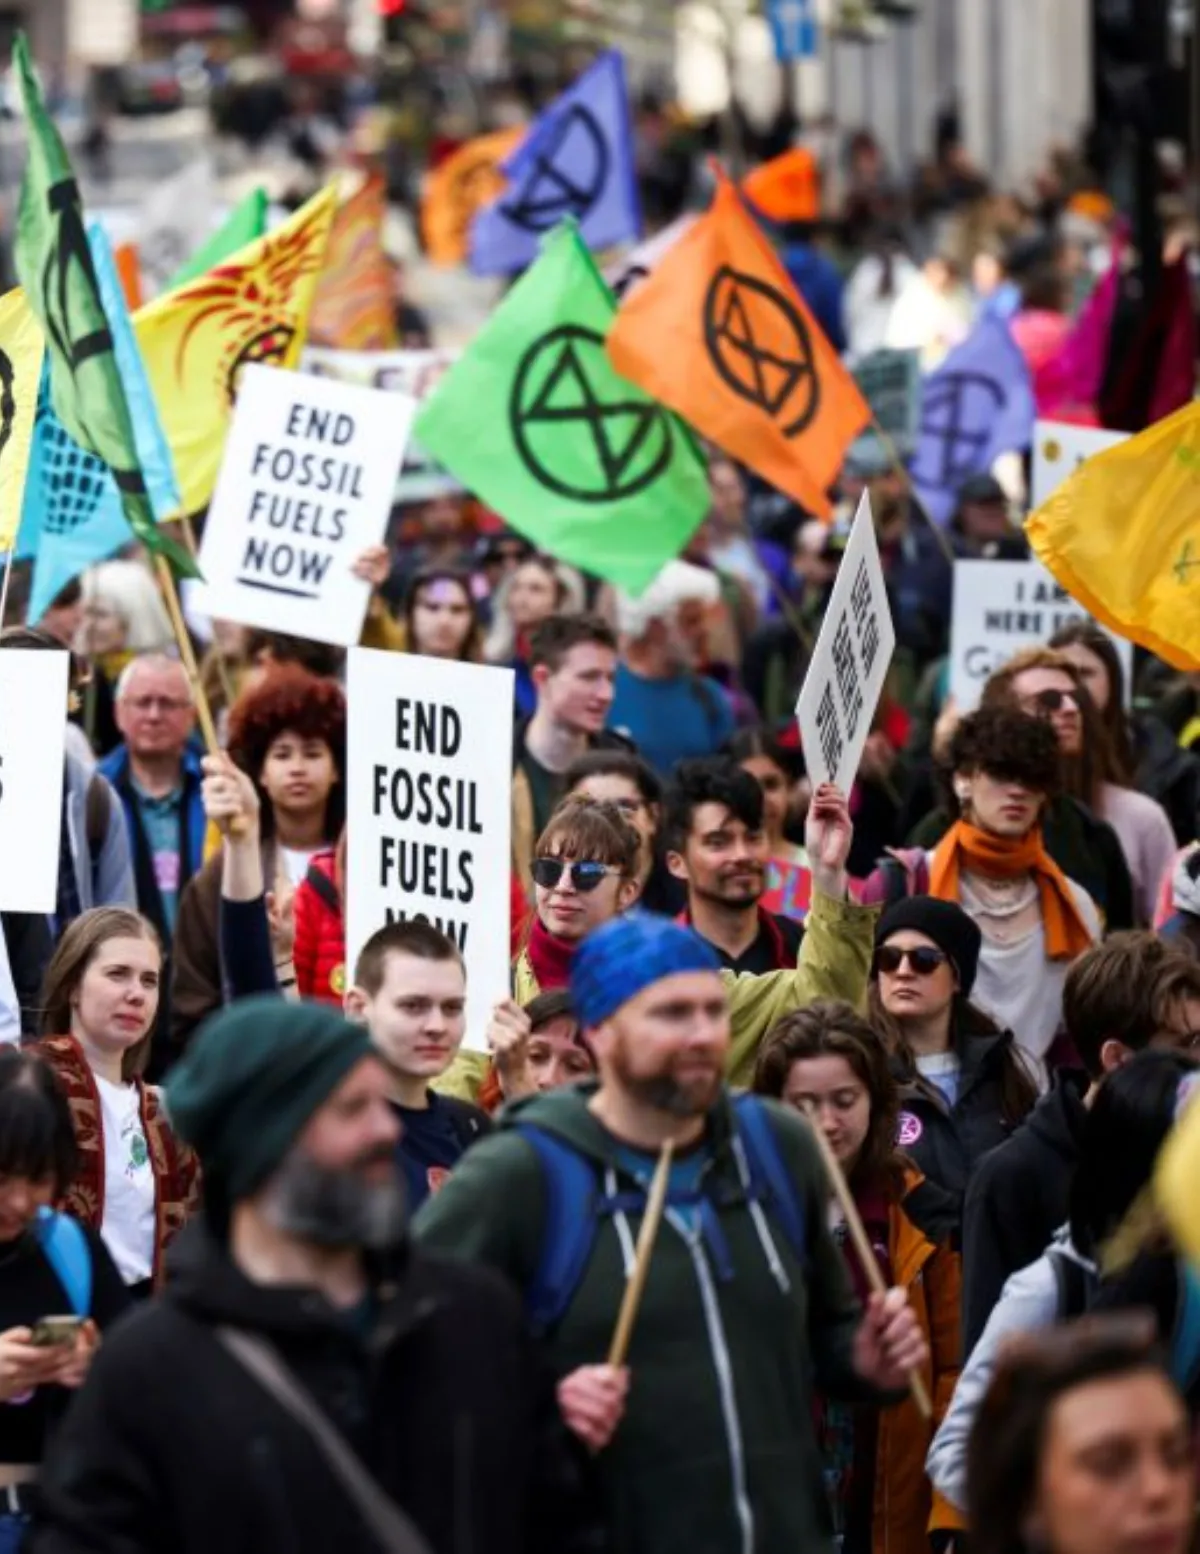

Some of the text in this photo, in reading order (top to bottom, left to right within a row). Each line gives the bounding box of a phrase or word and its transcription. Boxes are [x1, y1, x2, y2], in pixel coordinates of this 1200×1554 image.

[286, 403, 355, 446] END
[252, 443, 363, 499] FOSSIL
[248, 490, 348, 542] FUELS
[242, 537, 333, 585] NOW
[984, 609, 1042, 634] HERE
[396, 698, 461, 757] END
[374, 764, 482, 834] FOSSIL
[380, 836, 474, 904] FUELS
